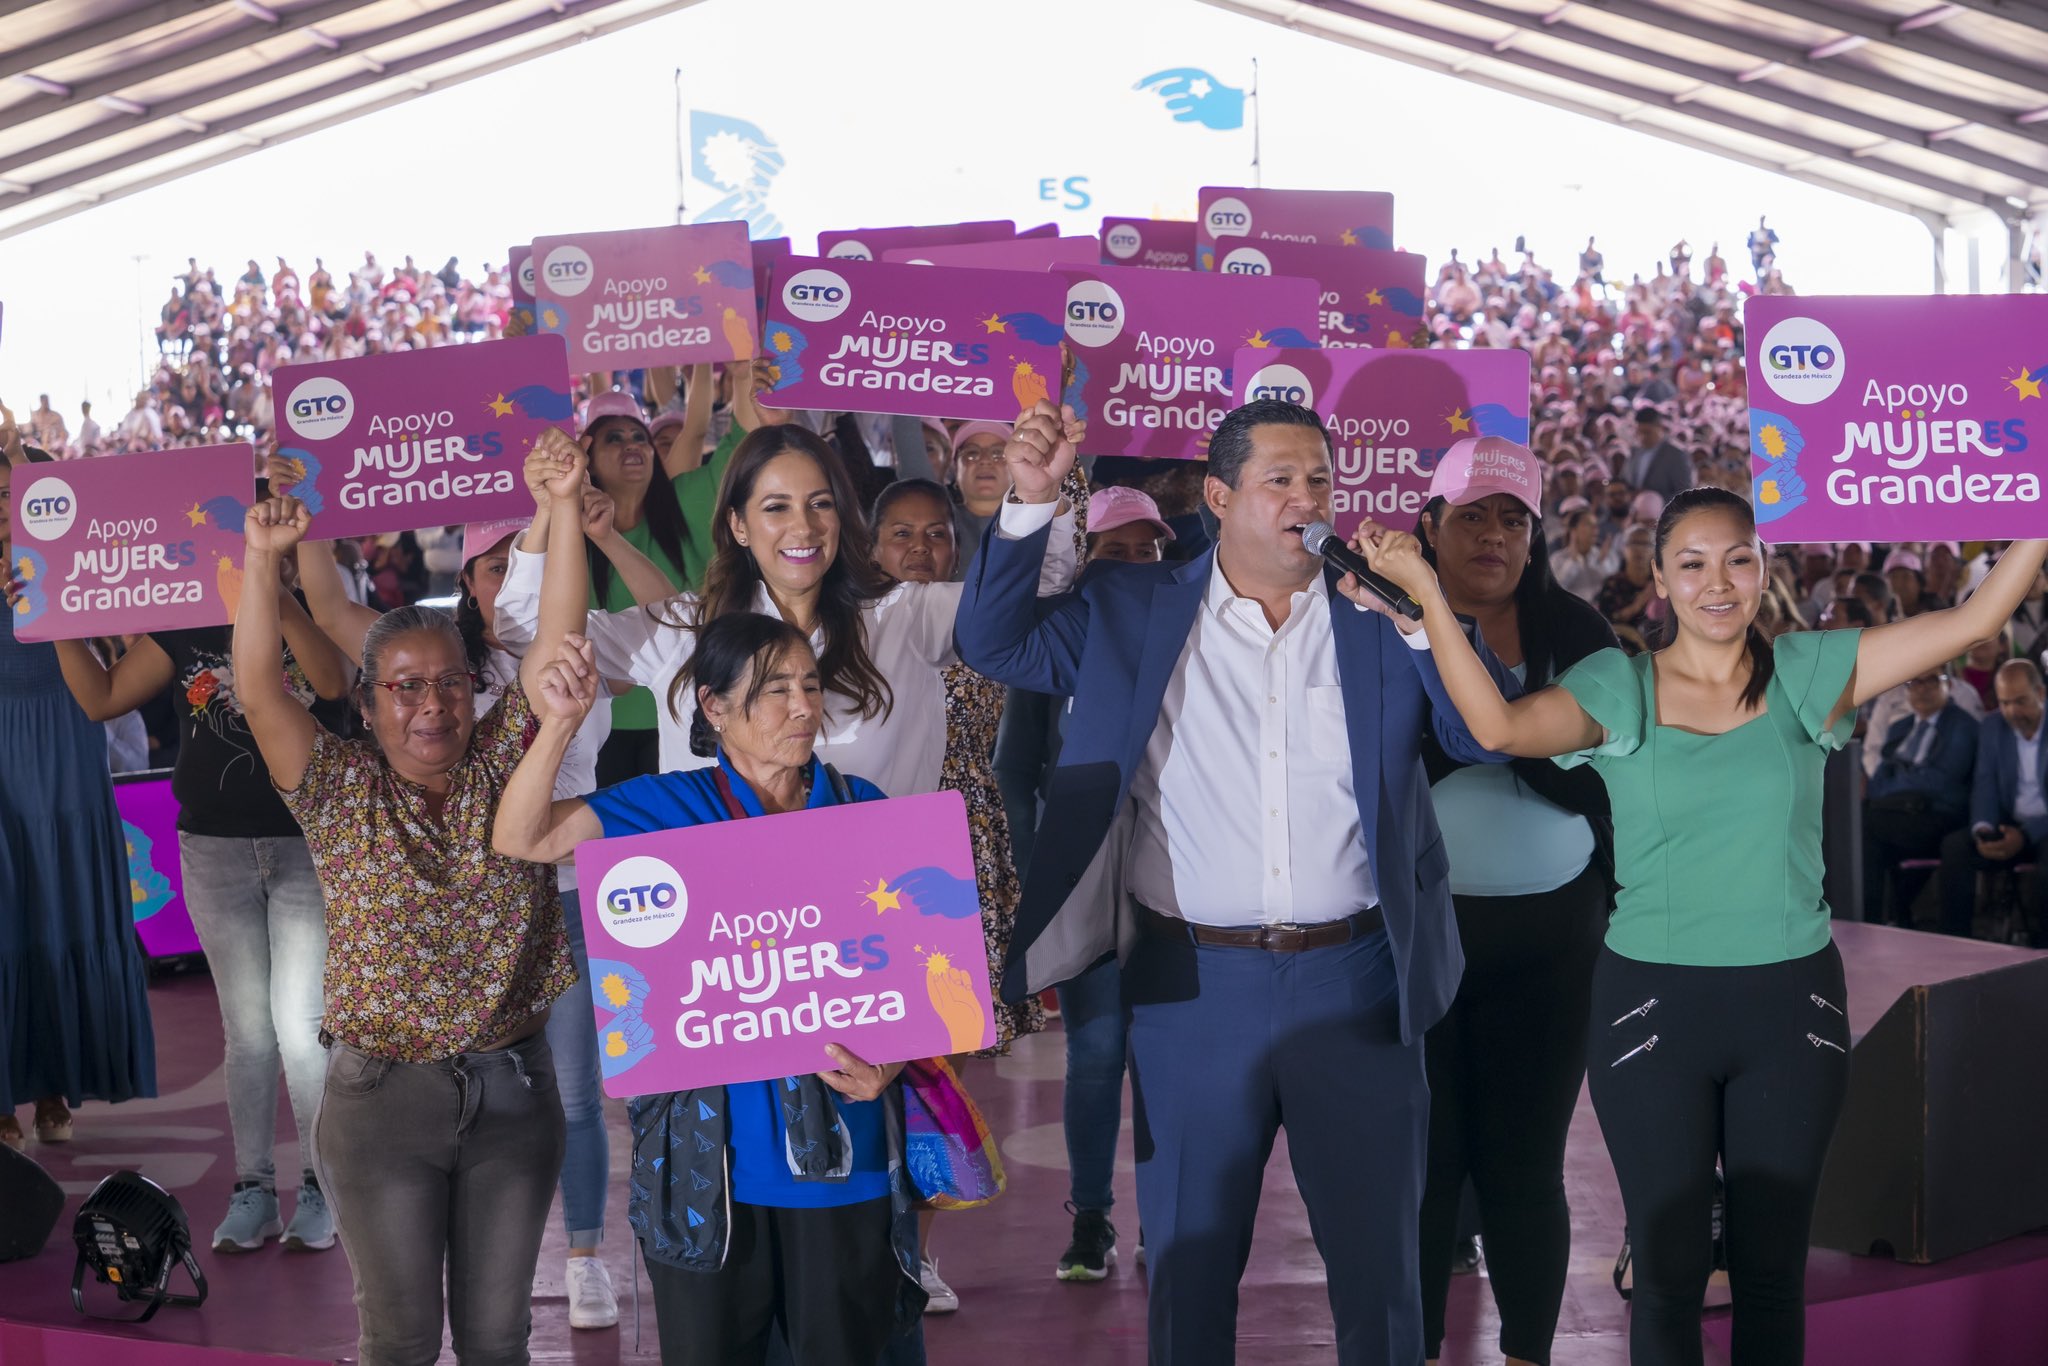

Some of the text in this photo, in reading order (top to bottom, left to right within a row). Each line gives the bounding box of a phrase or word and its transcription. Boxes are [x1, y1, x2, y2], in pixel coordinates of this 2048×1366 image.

[1211, 212, 1247, 226] GTO
[1111, 234, 1138, 246] GTO
[548, 261, 588, 277] GTO
[1227, 261, 1266, 275] GTO
[603, 277, 668, 298] Apoyo
[790, 284, 844, 302] GTO
[860, 311, 946, 337] Apoyo
[1068, 301, 1118, 322] GTO
[1319, 311, 1371, 333] ERES
[582, 325, 711, 353] Grandeza
[1135, 331, 1215, 359] Apoyo
[1769, 344, 1836, 371] GTO
[819, 363, 994, 397] Grandeza
[1109, 357, 1233, 402] MUJERE
[293, 395, 347, 417] GTO
[1253, 385, 1306, 405] GTO
[1862, 379, 1969, 414] Apoyo
[368, 410, 454, 438] Apoyo
[1103, 398, 1231, 430] Grande
[1326, 413, 1410, 442] Apoyo
[1333, 439, 1450, 486] UJERE
[1464, 465, 1528, 486] Grandeza
[339, 470, 515, 510] Grandeza
[1333, 483, 1430, 513] ande
[1826, 464, 2041, 506] Grandeza
[27, 496, 70, 517] GTO
[87, 518, 158, 543] Apoyo
[60, 577, 203, 613] Grandeza
[607, 882, 677, 916] GTO
[613, 916, 643, 925] Grandeza
[652, 911, 675, 920] México
[708, 904, 822, 945] Apoyo
[675, 990, 907, 1049] Grandeza
